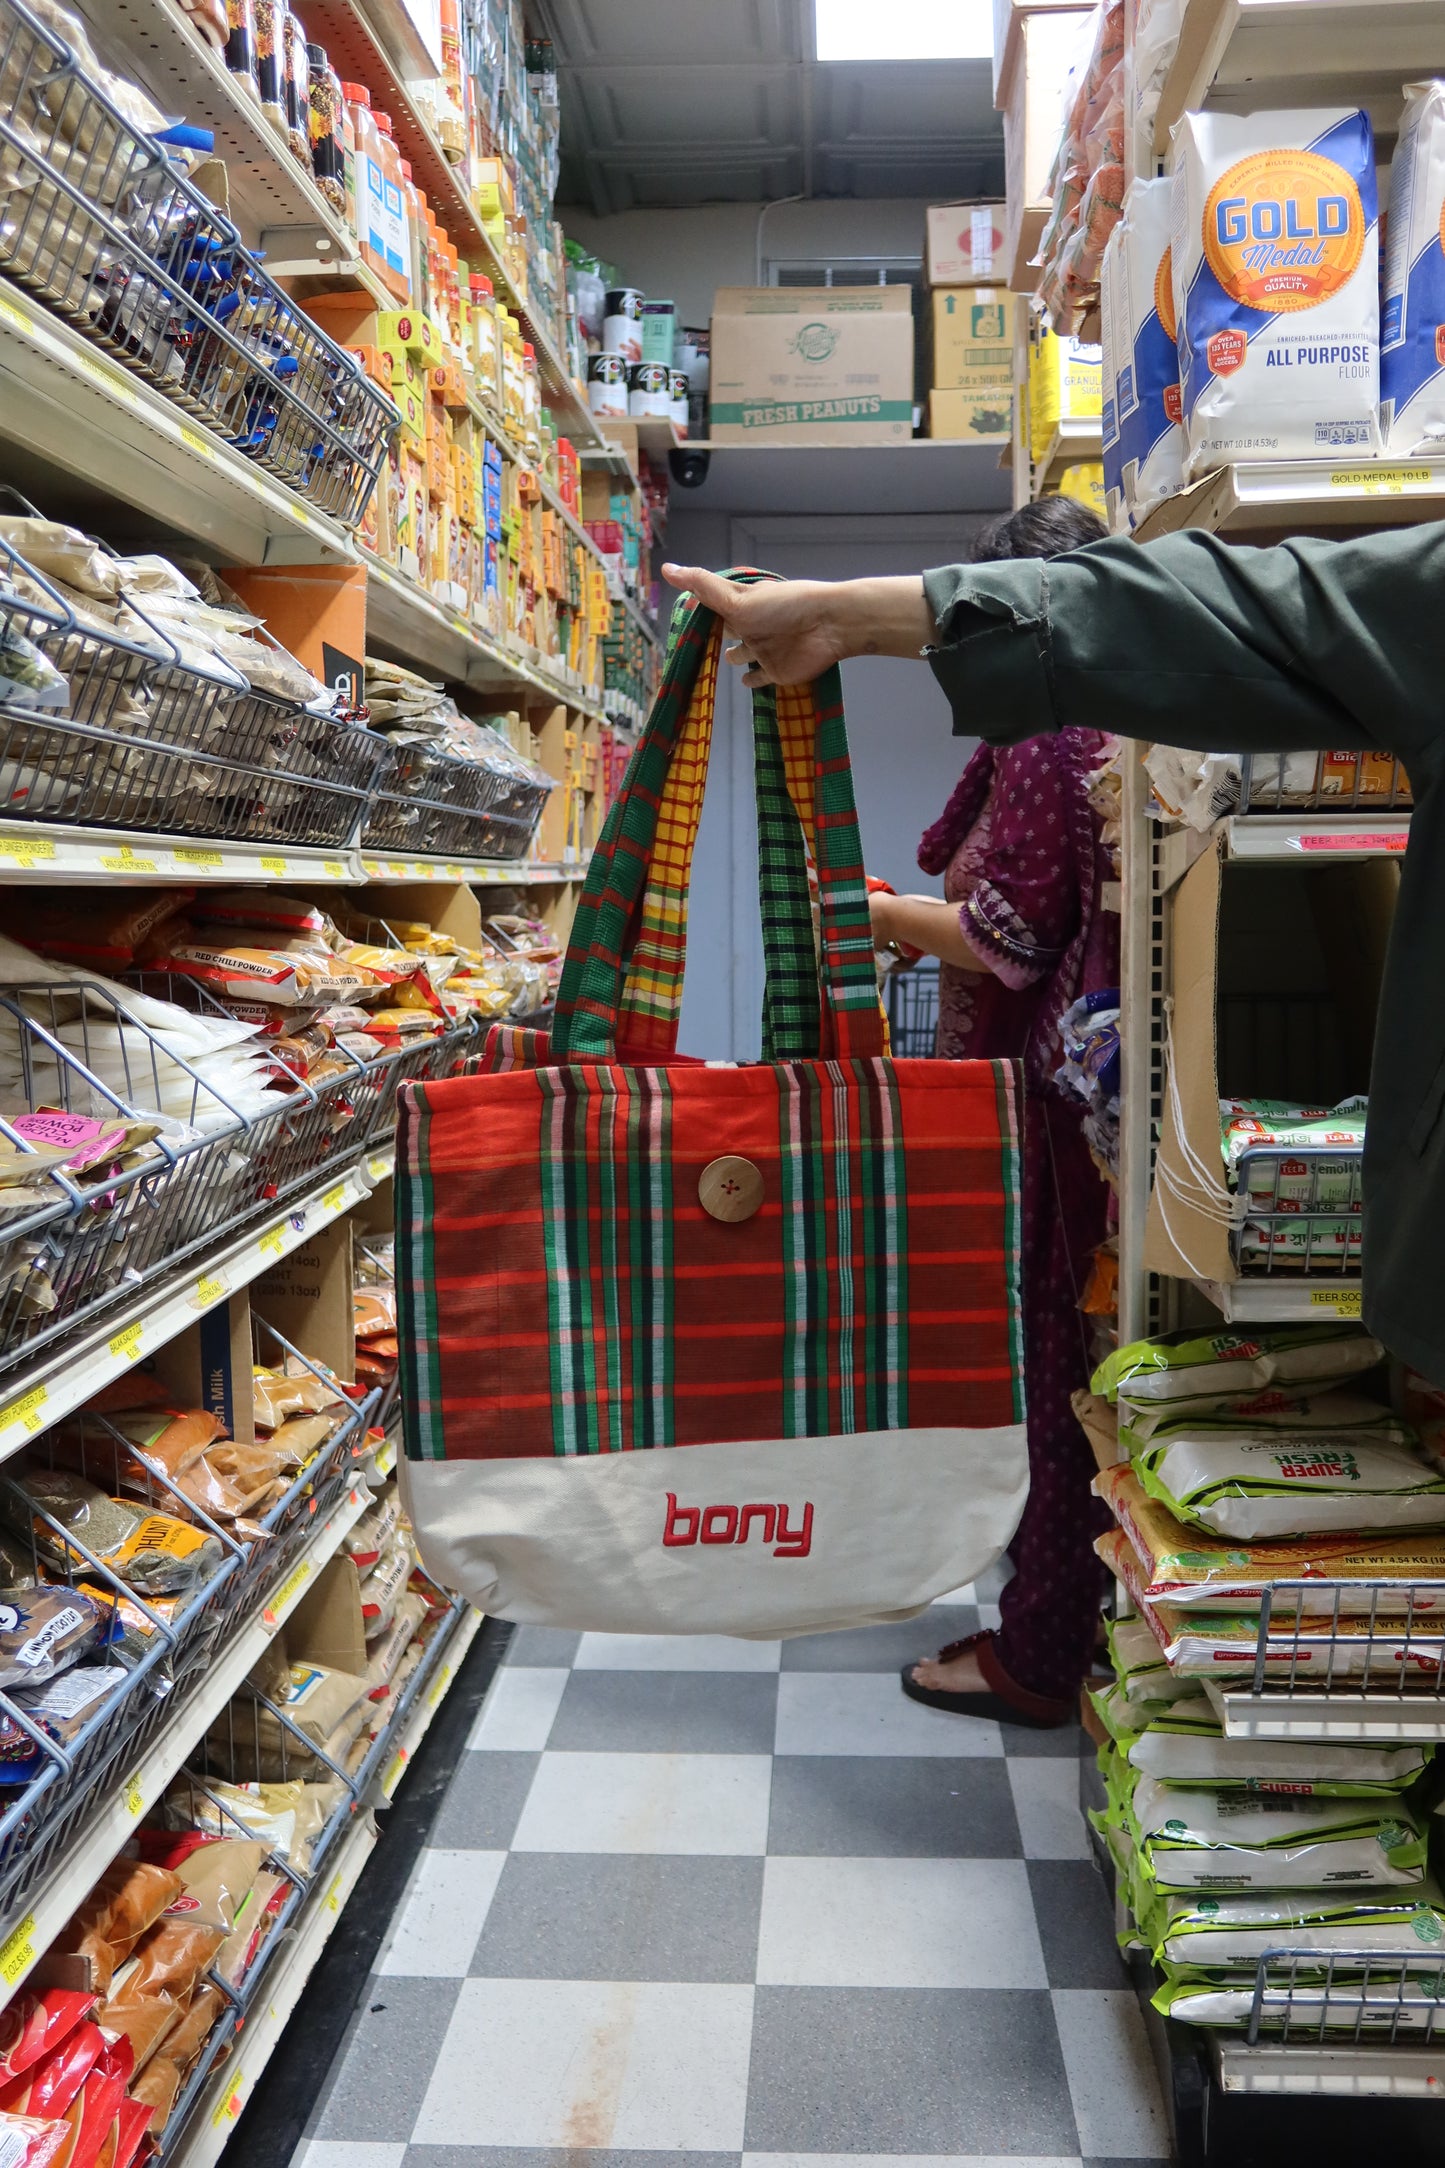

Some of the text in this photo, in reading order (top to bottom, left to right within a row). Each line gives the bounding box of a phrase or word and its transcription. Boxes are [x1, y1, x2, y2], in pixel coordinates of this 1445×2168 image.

[1229, 164, 1262, 189] EXPERTLY
[1307, 163, 1320, 172] THE
[1216, 195, 1349, 246] GOLD
[1241, 240, 1325, 275] Medal
[1264, 282, 1308, 292] QUALITY
[1221, 340, 1242, 350] YEARS
[1214, 359, 1239, 367] SUCCESS
[1266, 346, 1369, 367] ALL PURPOSE
[1339, 366, 1370, 379] FLOUR
[742, 396, 880, 427] FRESH PEANUTS
[1211, 437, 1278, 449] NET WT 10 LB (4.53kg)
[1304, 837, 1332, 845] TEER
[194, 952, 273, 975] RED CHILI POWDER
[229, 1006, 267, 1014] POWDER
[1282, 1164, 1306, 1174] TEER
[289, 1286, 321, 1299] 13oz)
[210, 1368, 224, 1400] Milk
[1274, 1451, 1356, 1465] FRESH
[1280, 1464, 1345, 1478] SUPER
[662, 1492, 814, 1557] bony
[1345, 1556, 1364, 1564] NET
[1366, 1556, 1387, 1564] WT.
[1389, 1556, 1410, 1564] 4.54
[1411, 1555, 1428, 1564] KG
[1421, 1621, 1437, 1629] KG
[1260, 1783, 1313, 1795] SUPER
